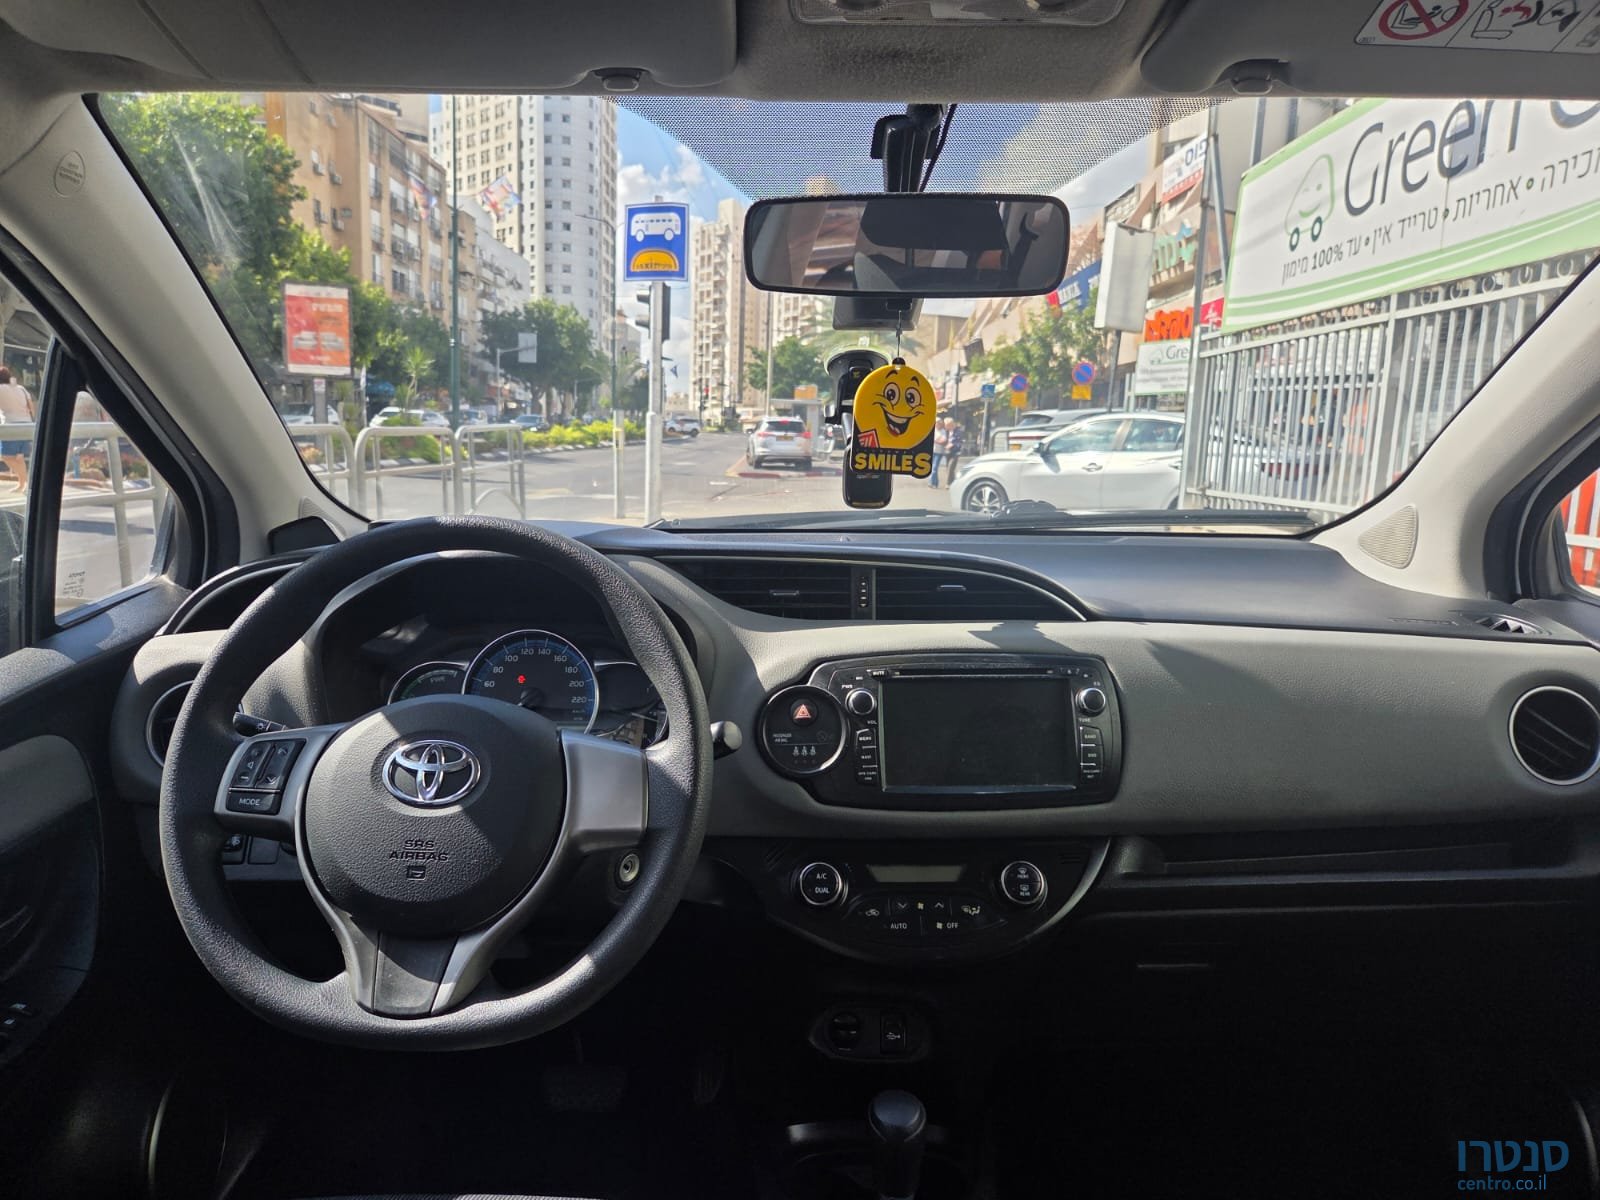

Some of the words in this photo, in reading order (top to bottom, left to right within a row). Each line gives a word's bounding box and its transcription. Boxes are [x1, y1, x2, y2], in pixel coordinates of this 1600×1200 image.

[1344, 99, 1523, 217] Green
[1452, 175, 1522, 222] אחריות
[1397, 206, 1439, 239] טרייד
[1346, 235, 1363, 257] עד
[1371, 223, 1394, 256] אין
[1311, 242, 1345, 271] 100%
[1281, 255, 1309, 286] מימון
[854, 452, 932, 476] SMILES
[520, 647, 534, 655] 120
[537, 647, 551, 655] 140
[492, 666, 504, 674] 80
[483, 680, 495, 688] 60
[239, 797, 261, 806] MODE
[404, 839, 435, 849] SRS
[389, 850, 449, 862] AIRBAG
